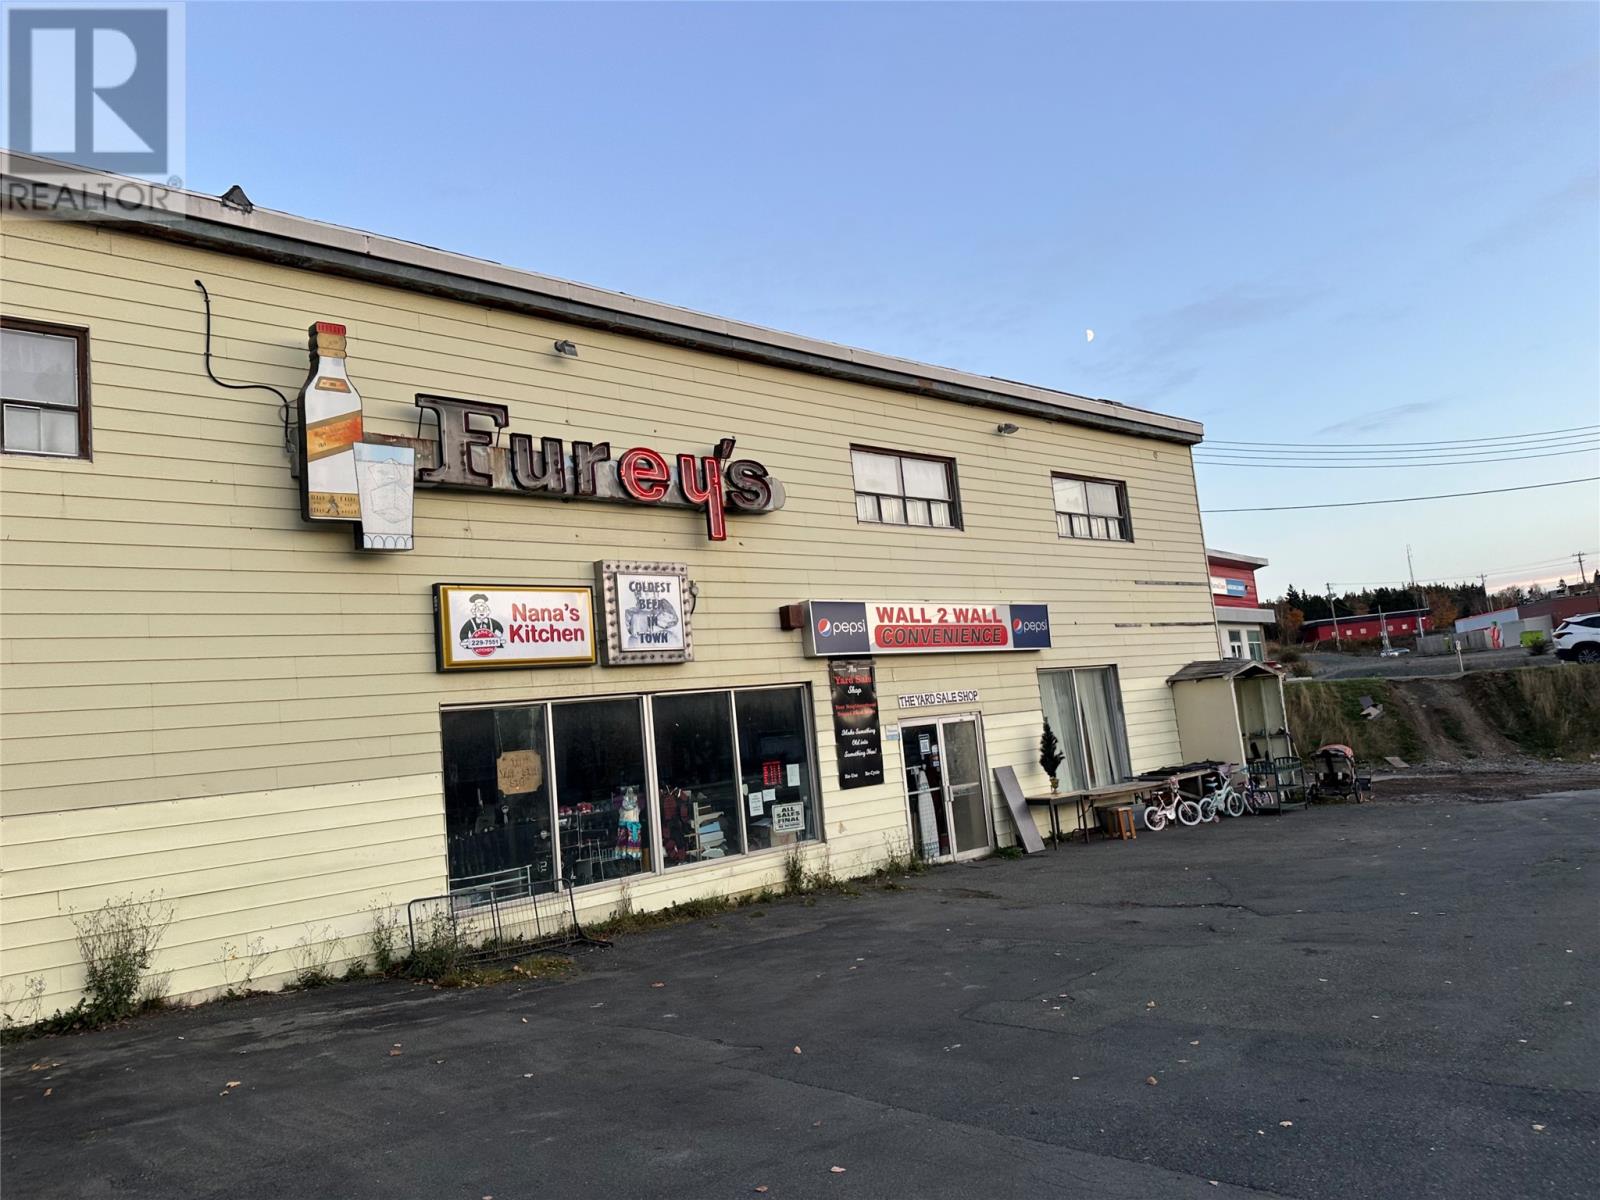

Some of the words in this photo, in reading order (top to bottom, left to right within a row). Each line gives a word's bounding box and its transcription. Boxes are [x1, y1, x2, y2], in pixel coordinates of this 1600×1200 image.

[415, 393, 773, 541] Furey's
[629, 581, 671, 593] COLDEST
[511, 603, 580, 622] Nana's
[876, 607, 931, 623] WALL
[937, 608, 948, 623] 2
[953, 608, 1002, 623] WALL
[509, 624, 585, 643] Kitchen
[833, 619, 866, 636] pepsi
[1023, 619, 1048, 632] pepsi
[638, 632, 668, 643] TOWN
[882, 628, 1001, 644] CONVENIENCE
[848, 685, 862, 696] Shop
[900, 696, 915, 707] THE
[915, 694, 935, 705] YARD
[936, 692, 957, 703] SALE
[958, 691, 978, 702] SHOP
